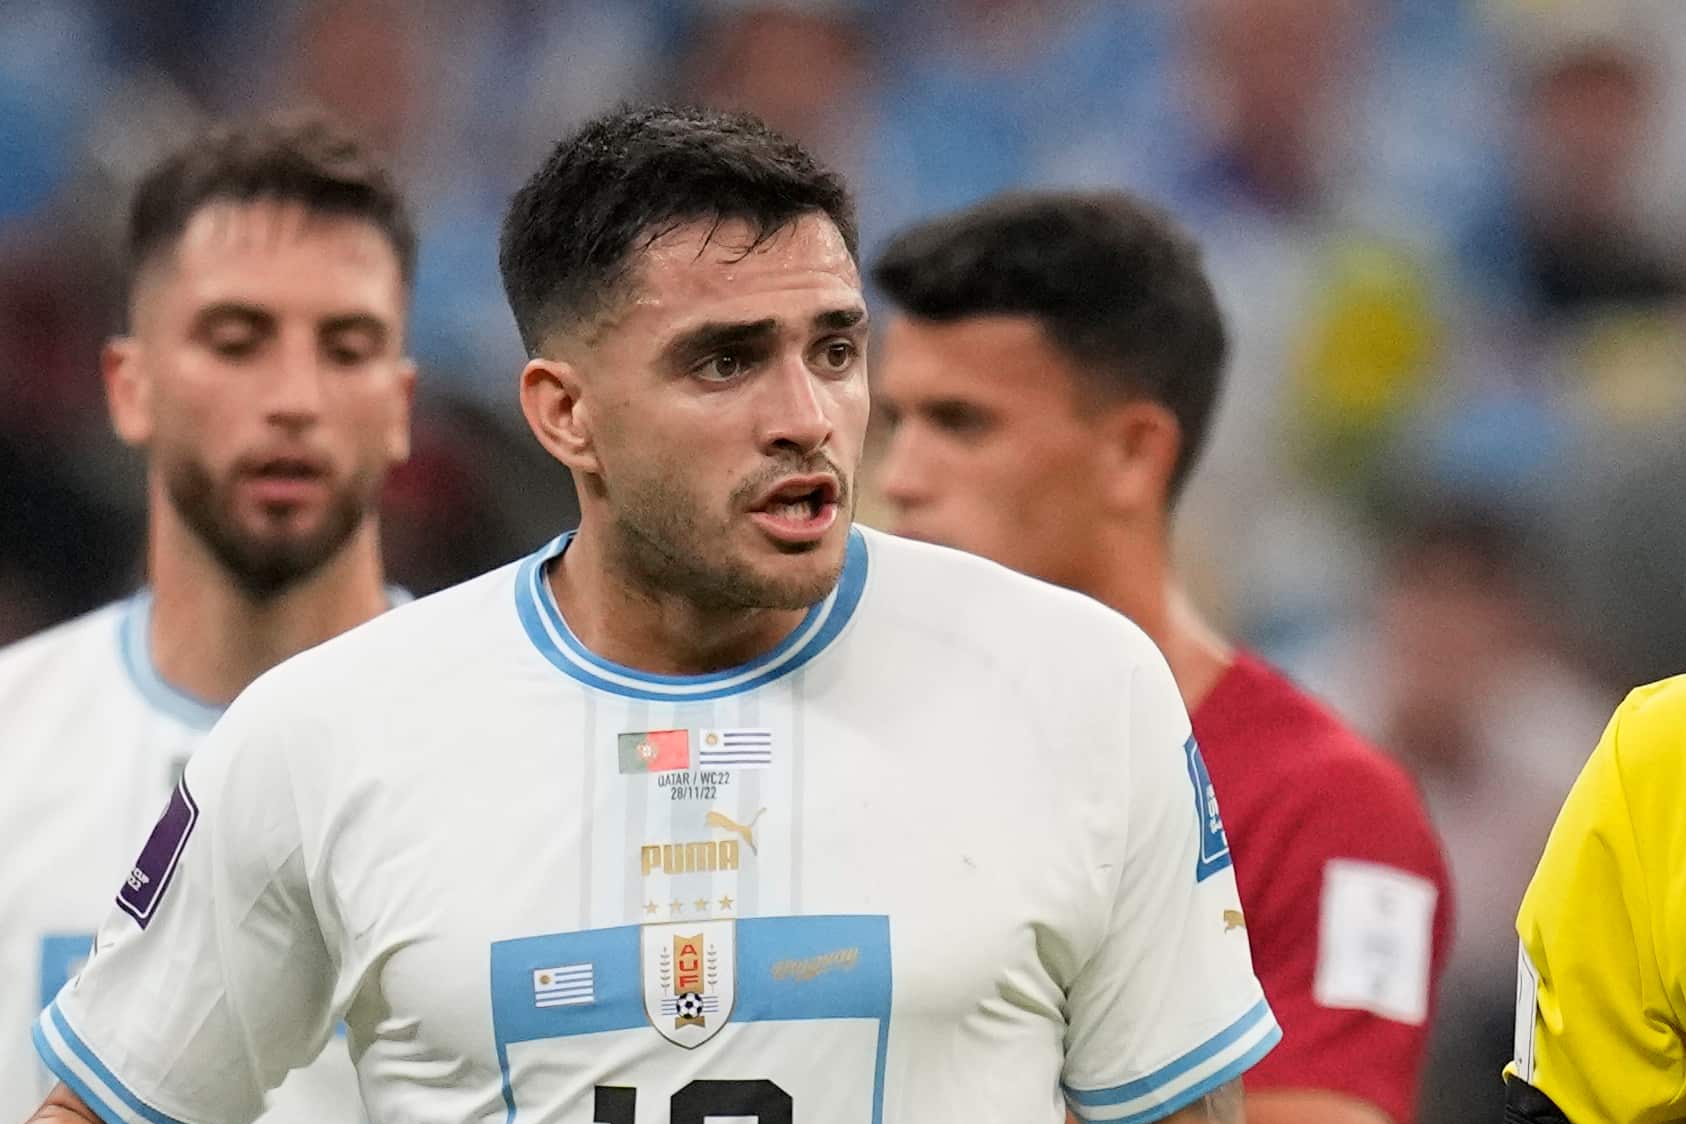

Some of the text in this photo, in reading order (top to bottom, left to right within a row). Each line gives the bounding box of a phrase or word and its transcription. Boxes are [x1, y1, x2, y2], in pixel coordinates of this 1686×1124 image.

[657, 773, 690, 787] QATAR
[700, 771, 731, 786] WC22
[670, 786, 717, 800] 28/11/22
[641, 840, 739, 876] PUMA
[679, 944, 699, 988] AUF
